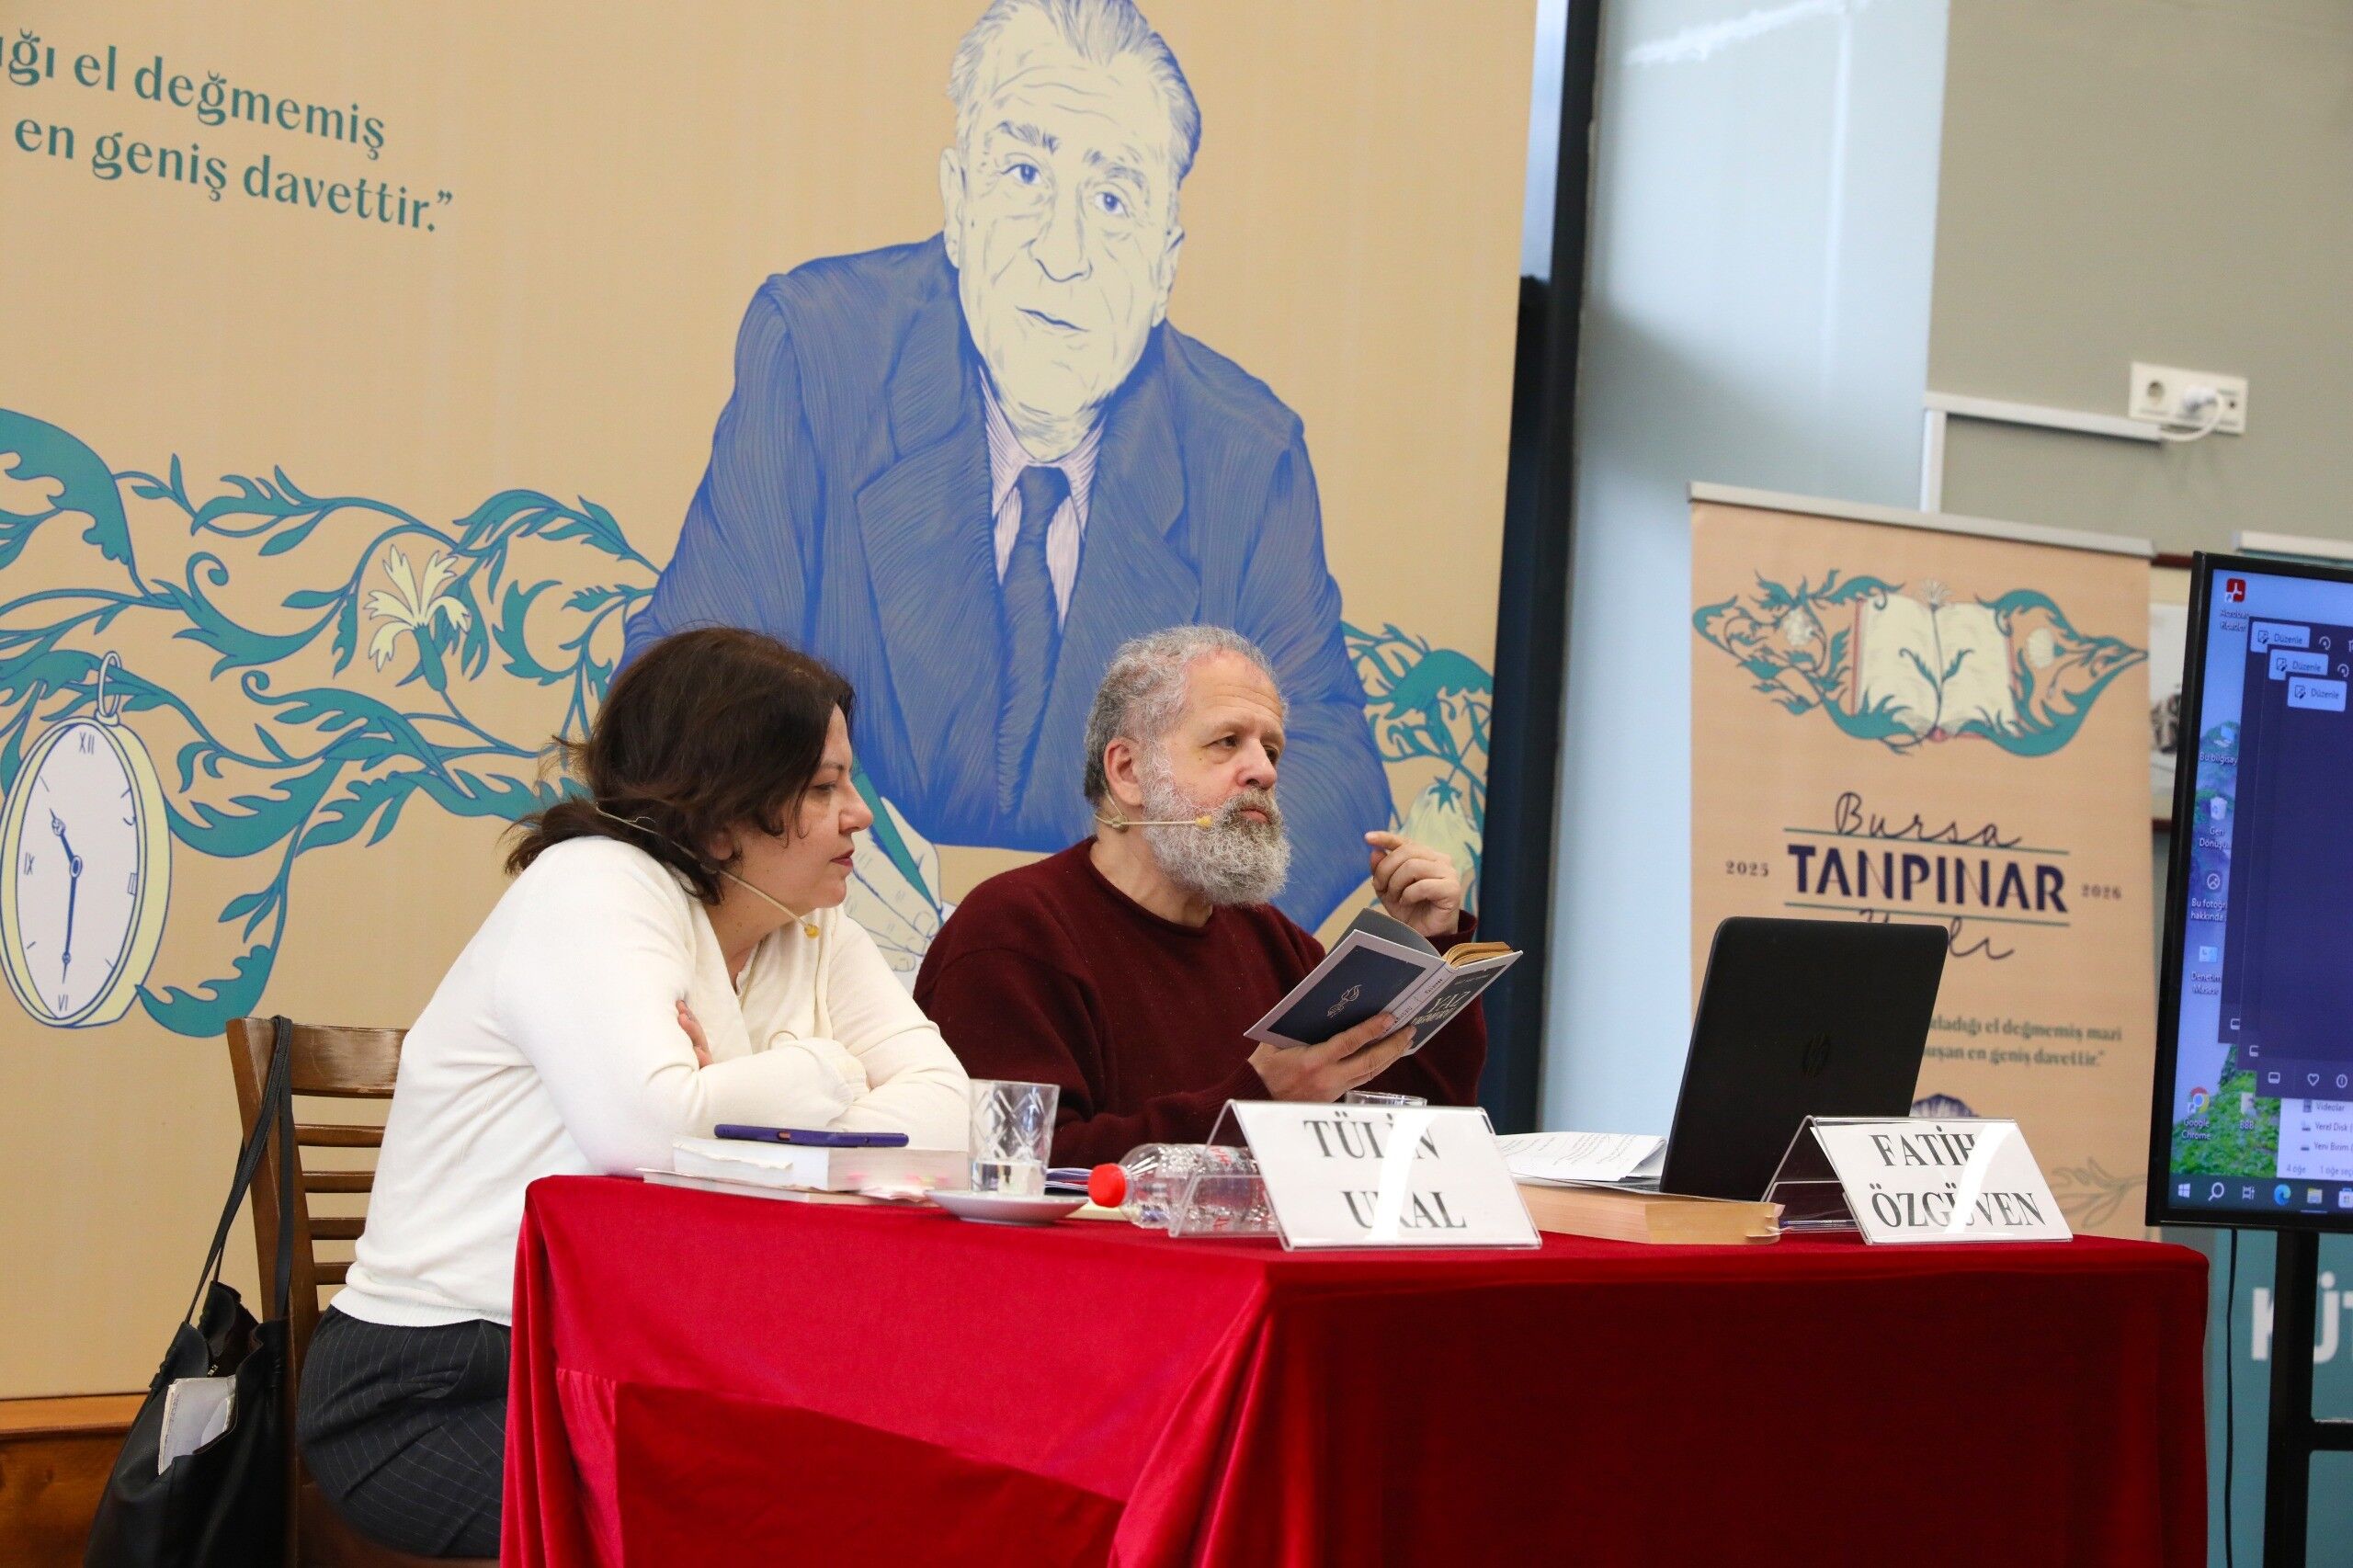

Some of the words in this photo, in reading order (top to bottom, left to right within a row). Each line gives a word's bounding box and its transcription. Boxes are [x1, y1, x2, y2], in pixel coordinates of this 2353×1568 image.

[0, 28, 55, 85] ğı
[74, 45, 117, 91] el
[134, 56, 385, 160] değmemiş
[15, 118, 74, 160] en
[92, 131, 227, 202] geniş
[243, 154, 453, 233] davettir.”
[2274, 632, 2303, 644] Düzenle
[2292, 660, 2322, 672] Düzenle
[2311, 687, 2340, 699] Düzenle
[1835, 791, 2022, 848] Bursa
[1725, 860, 1769, 877] 2025
[1787, 843, 2068, 914] TANPINAR
[1985, 1017, 1999, 1034] el
[1968, 1049, 1986, 1060] en
[1341, 1190, 1469, 1229] UAL
